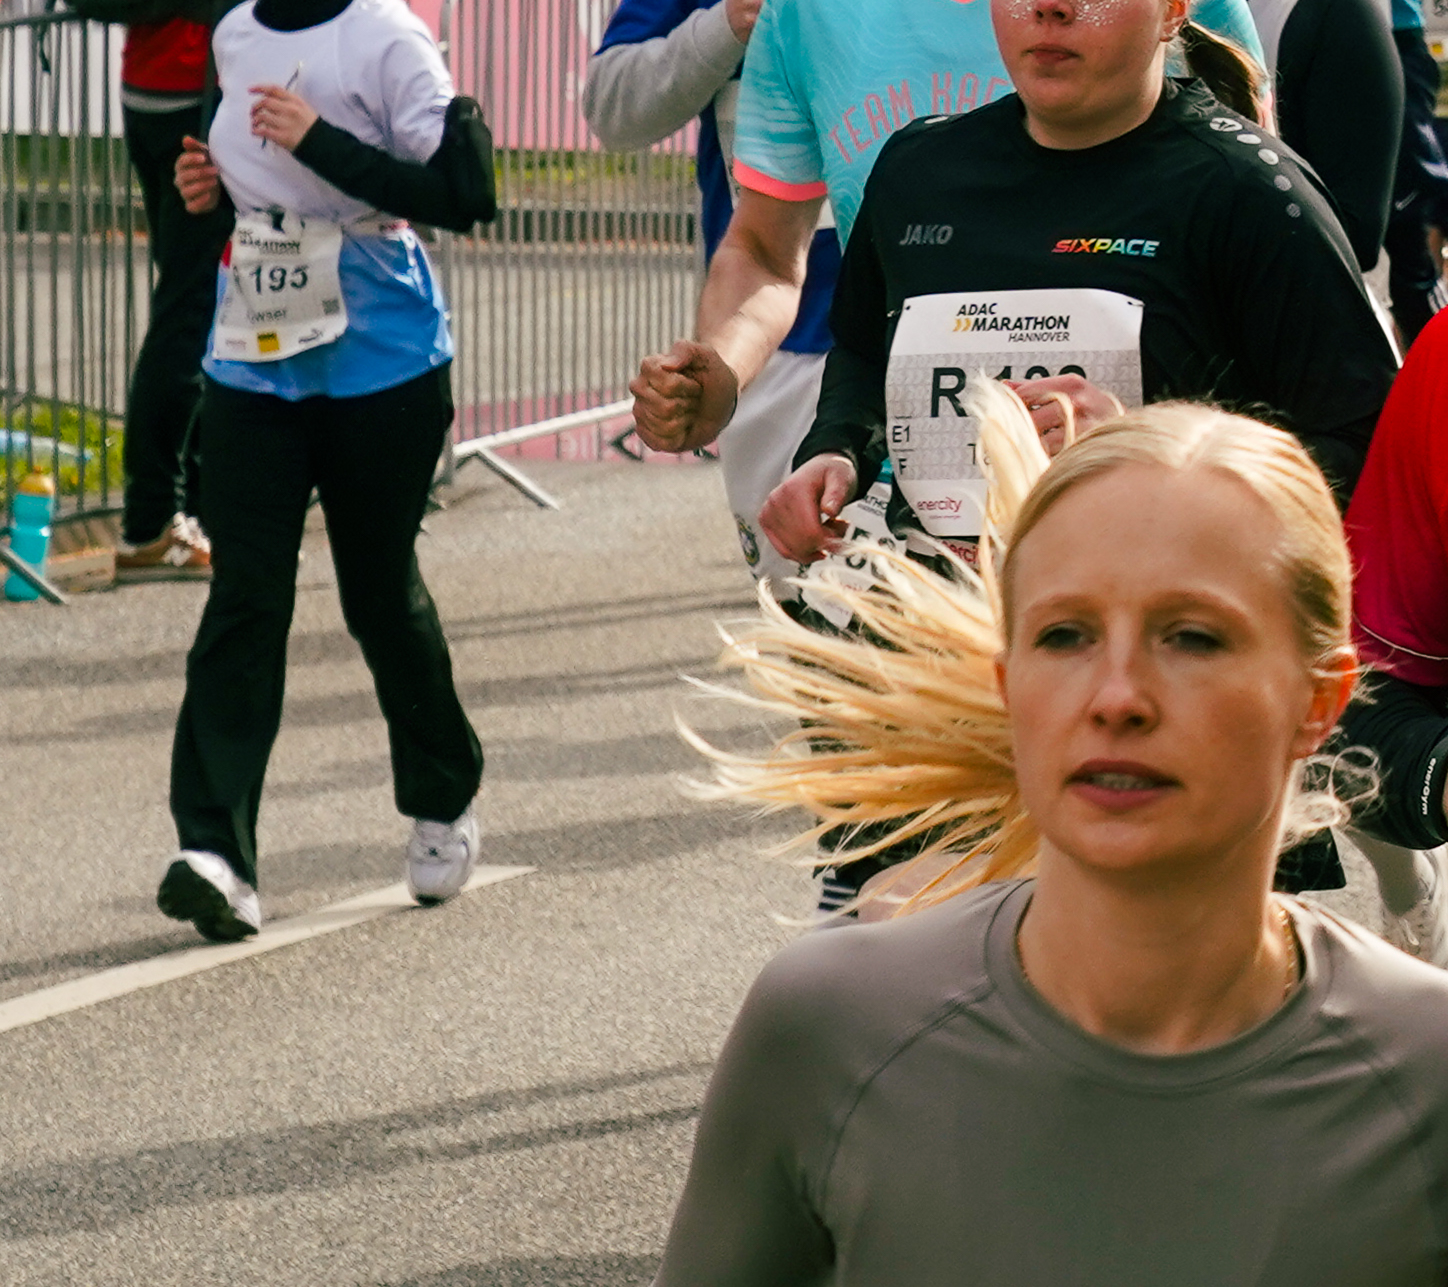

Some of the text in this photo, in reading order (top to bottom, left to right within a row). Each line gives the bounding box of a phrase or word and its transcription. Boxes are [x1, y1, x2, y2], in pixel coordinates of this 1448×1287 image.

[829, 80, 915, 163] TEAM
[900, 224, 954, 246] JAKO
[1052, 238, 1160, 257] SIXPACE
[957, 303, 998, 316] ADAC
[971, 315, 1070, 332] MARATHON
[1009, 331, 1070, 342] HANNOVER
[930, 367, 968, 418] R
[892, 425, 911, 443] E1
